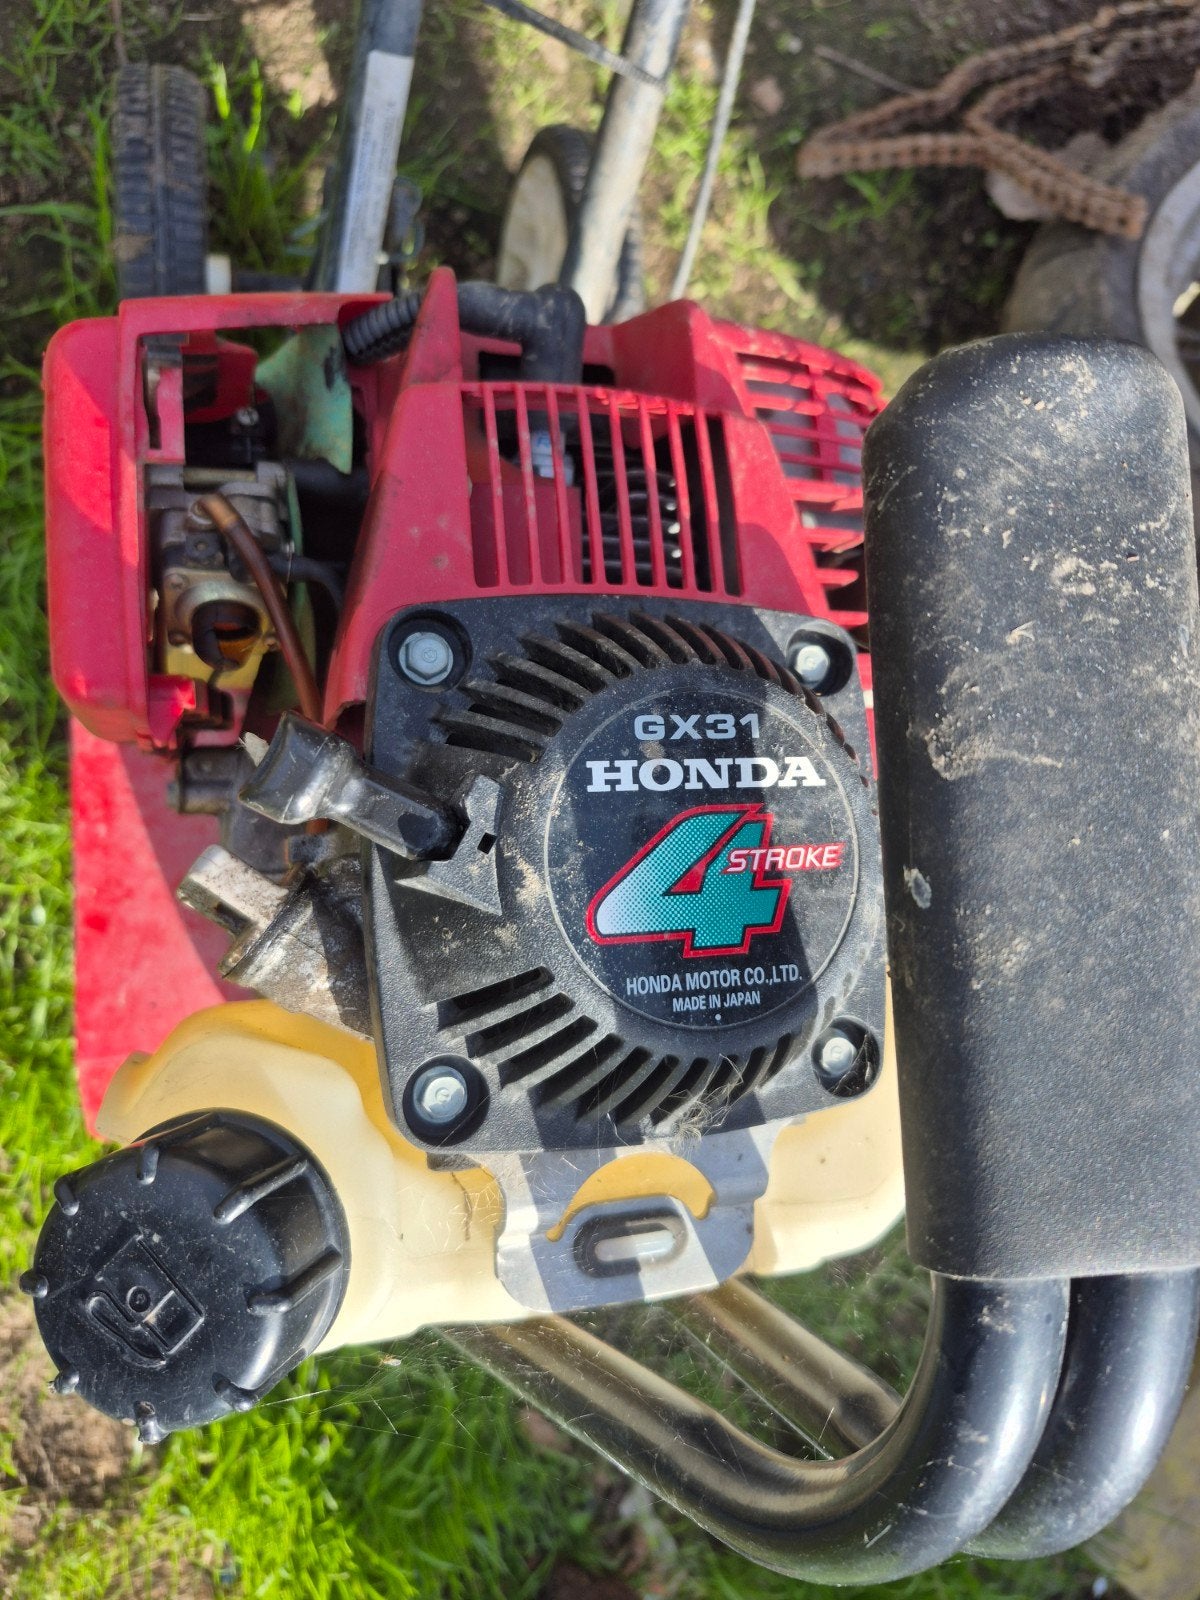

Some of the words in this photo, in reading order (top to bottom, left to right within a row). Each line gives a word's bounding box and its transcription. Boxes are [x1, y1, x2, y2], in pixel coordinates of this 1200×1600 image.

[634, 713, 760, 740] GX31
[585, 756, 826, 793] HONDA
[585, 803, 792, 959] 4
[725, 844, 842, 873] STROKE
[626, 974, 683, 996] HONDA
[686, 968, 741, 990] MOTOR
[672, 995, 706, 1012] MADE
[709, 993, 721, 1009] IN
[723, 990, 761, 1008] JAPAN
